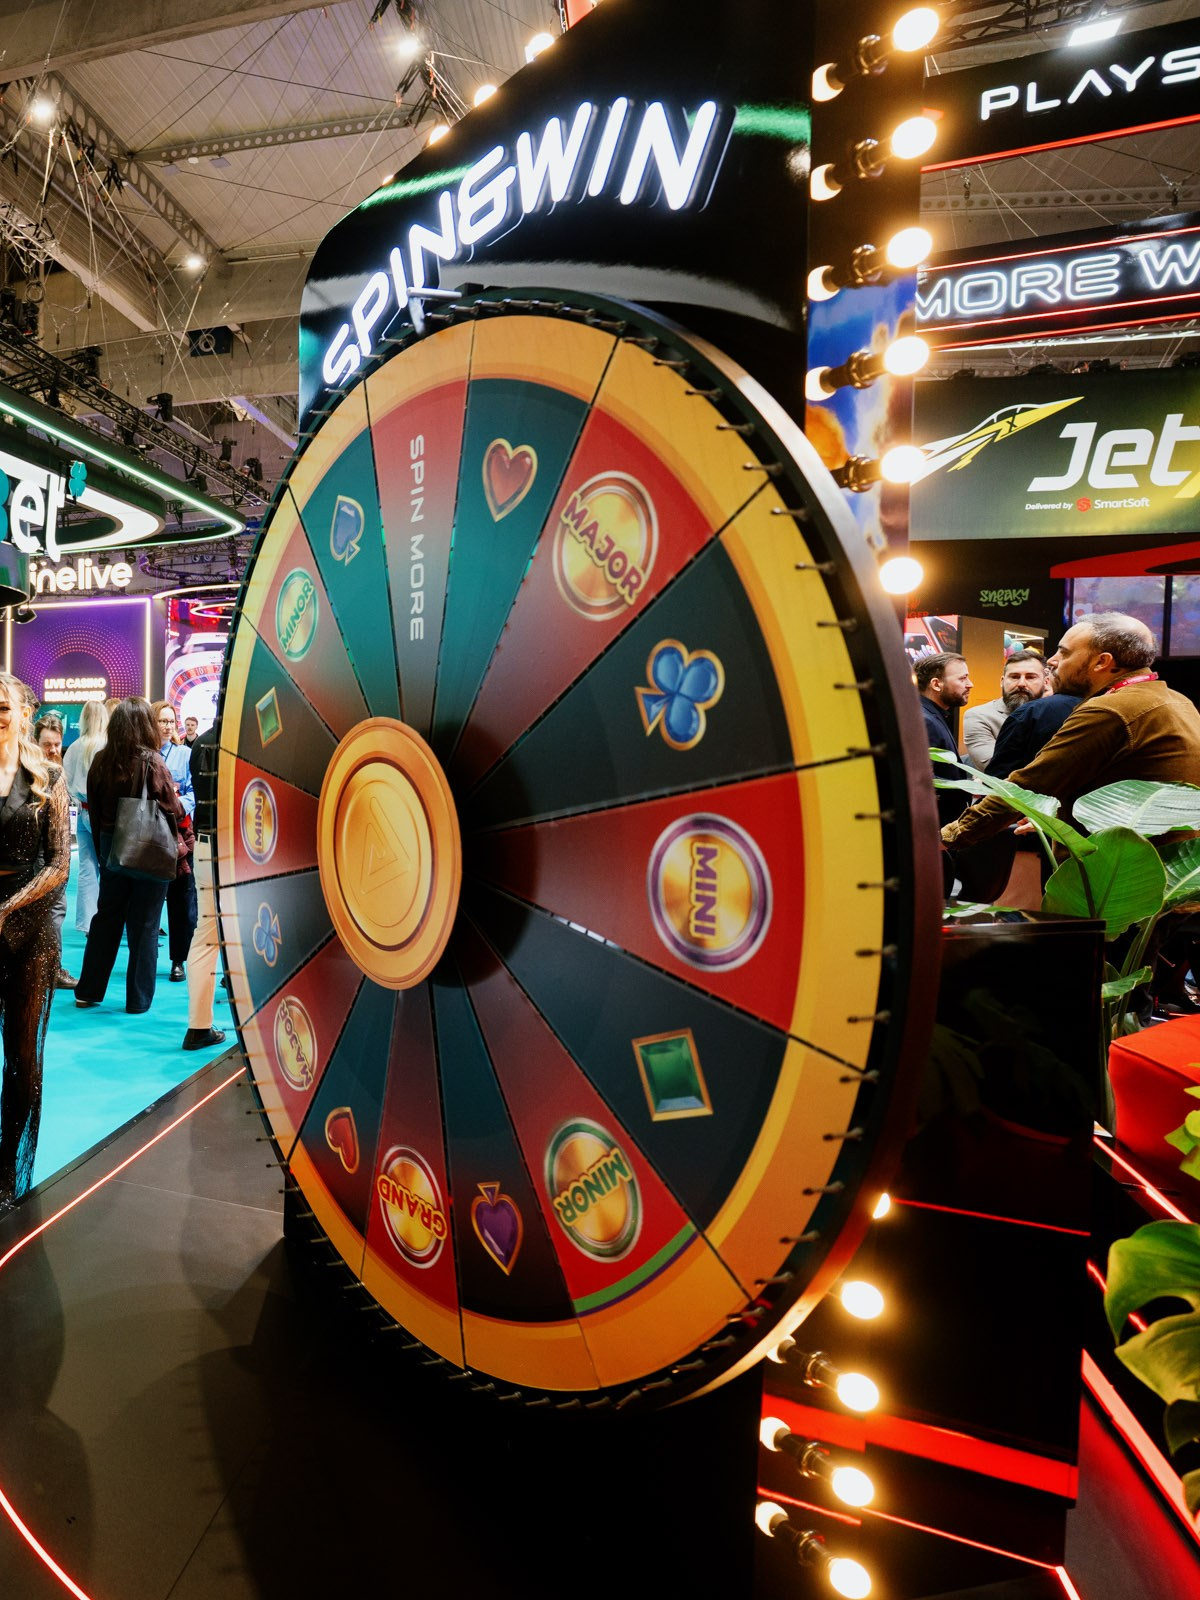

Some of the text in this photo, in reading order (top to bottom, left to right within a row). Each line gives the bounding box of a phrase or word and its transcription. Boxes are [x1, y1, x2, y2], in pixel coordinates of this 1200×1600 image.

[981, 45, 1200, 121] PLAYS
[915, 253, 1121, 320] MORE
[410, 434, 425, 641] SPIN MORE
[1025, 503, 1061, 511] Delivered
[1063, 503, 1074, 511] by
[1094, 497, 1151, 509] SmartSoft
[562, 493, 644, 603] MAJOR
[281, 580, 313, 651] MINOR
[44, 677, 107, 689] LIVE CASINO
[692, 844, 720, 937] MINI
[280, 1001, 312, 1087] MAJOR
[378, 1176, 447, 1239] GRAND
[555, 1151, 631, 1224] MINOR
